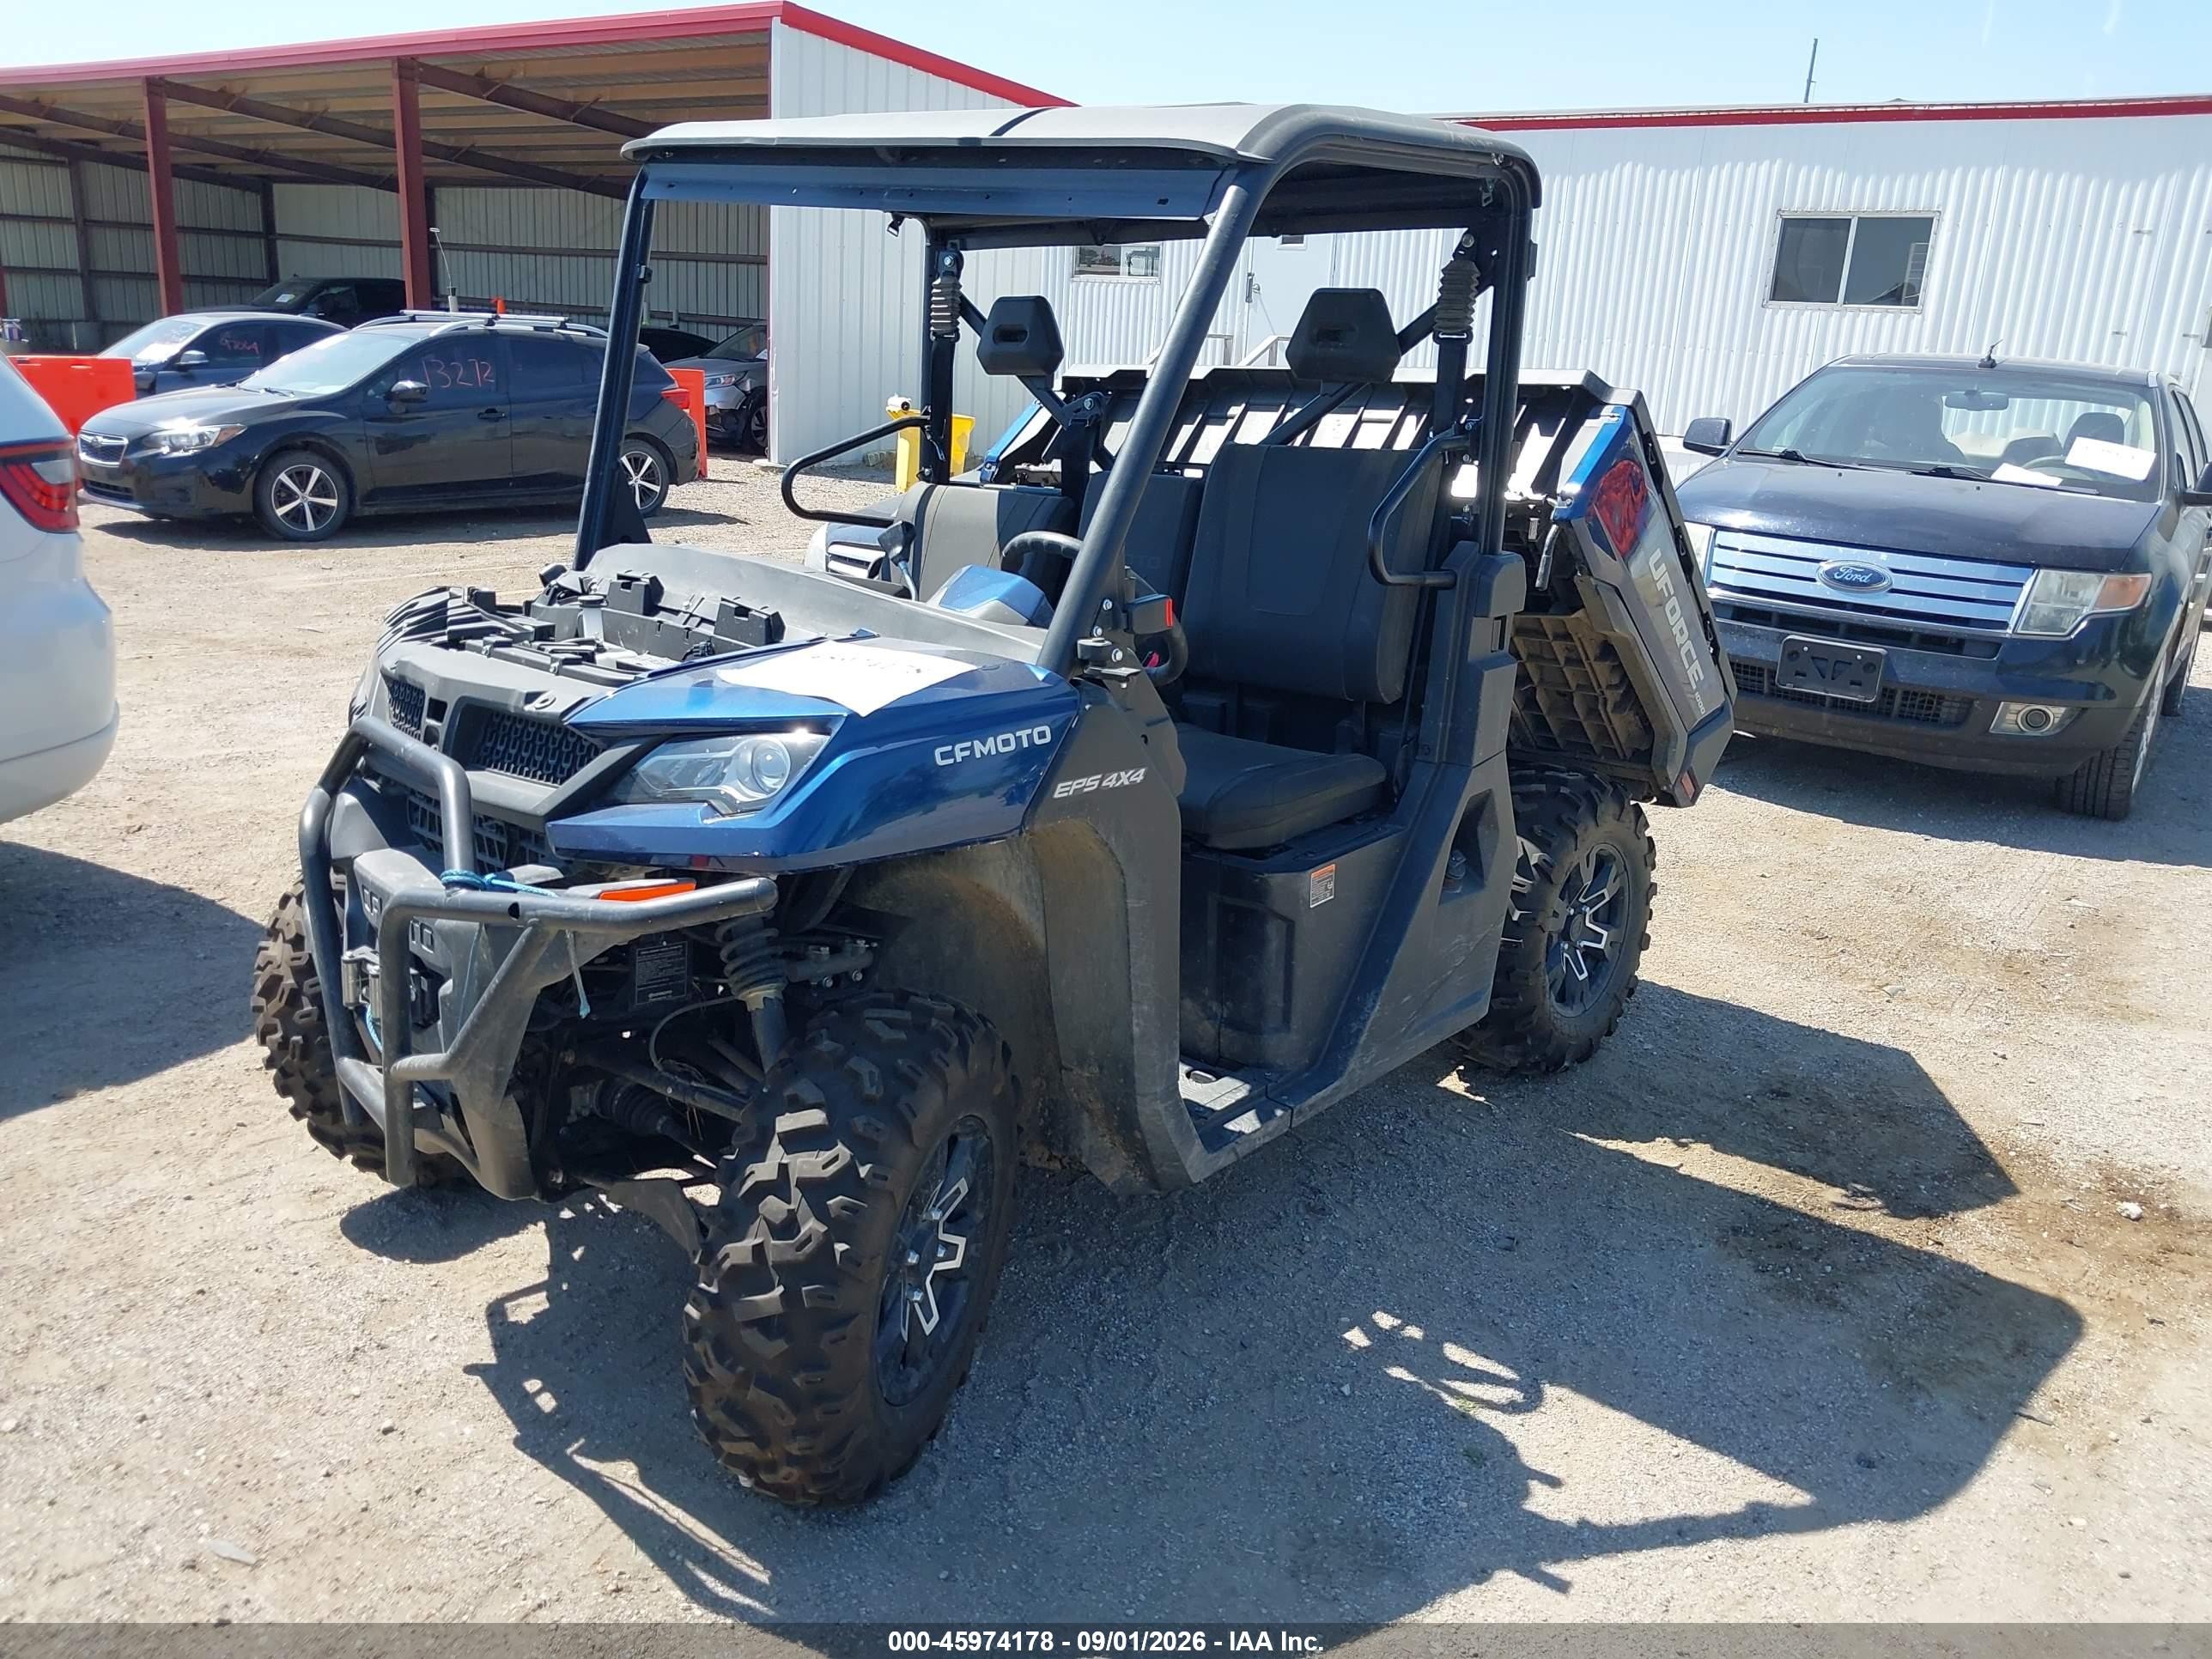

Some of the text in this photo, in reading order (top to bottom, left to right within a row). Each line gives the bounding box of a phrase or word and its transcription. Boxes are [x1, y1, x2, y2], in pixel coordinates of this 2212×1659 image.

[421, 358, 495, 390] 13272
[1833, 566, 1874, 583] Ford
[1648, 547, 1706, 715] UFORCE 1000
[934, 725, 1052, 766] CFMOTO
[1053, 767, 1149, 799] EPS 4X4
